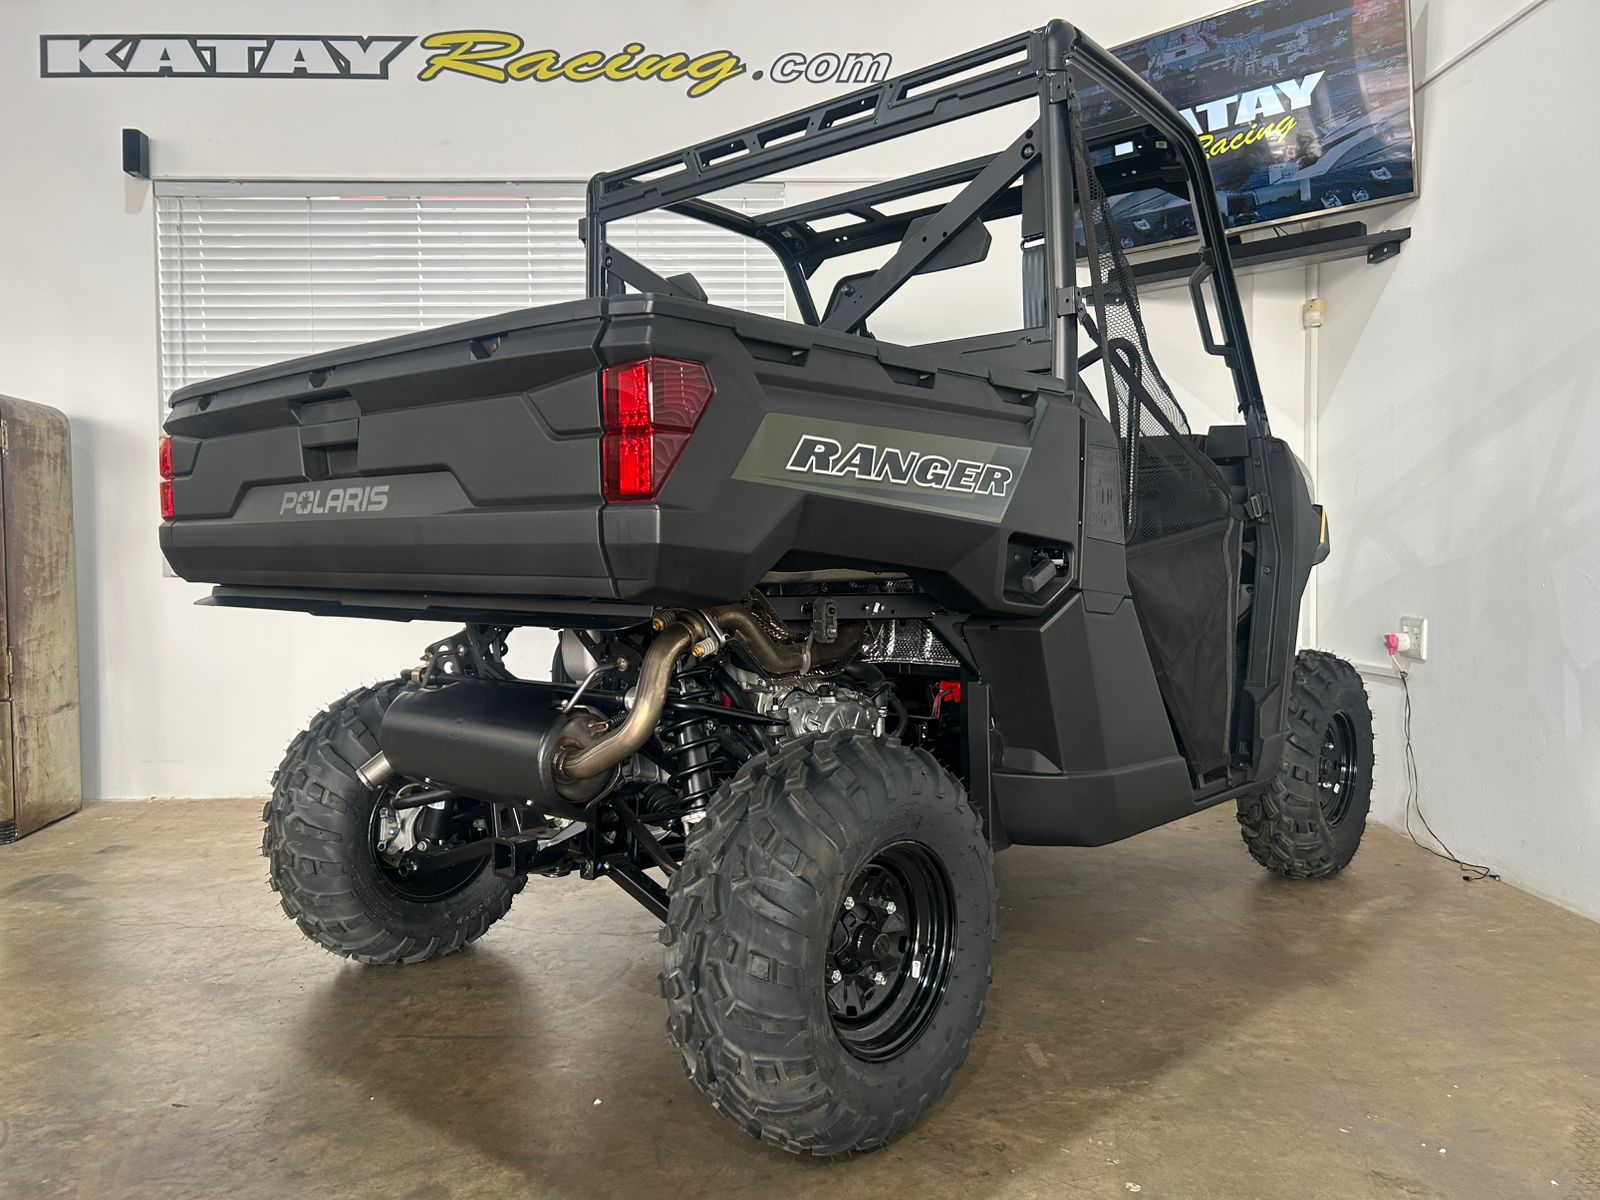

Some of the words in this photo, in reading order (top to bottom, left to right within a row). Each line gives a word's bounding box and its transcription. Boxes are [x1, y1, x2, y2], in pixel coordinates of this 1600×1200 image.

[40, 34, 418, 80] KATAY
[786, 434, 1013, 496] RANGER
[279, 484, 390, 515] POLARIS
